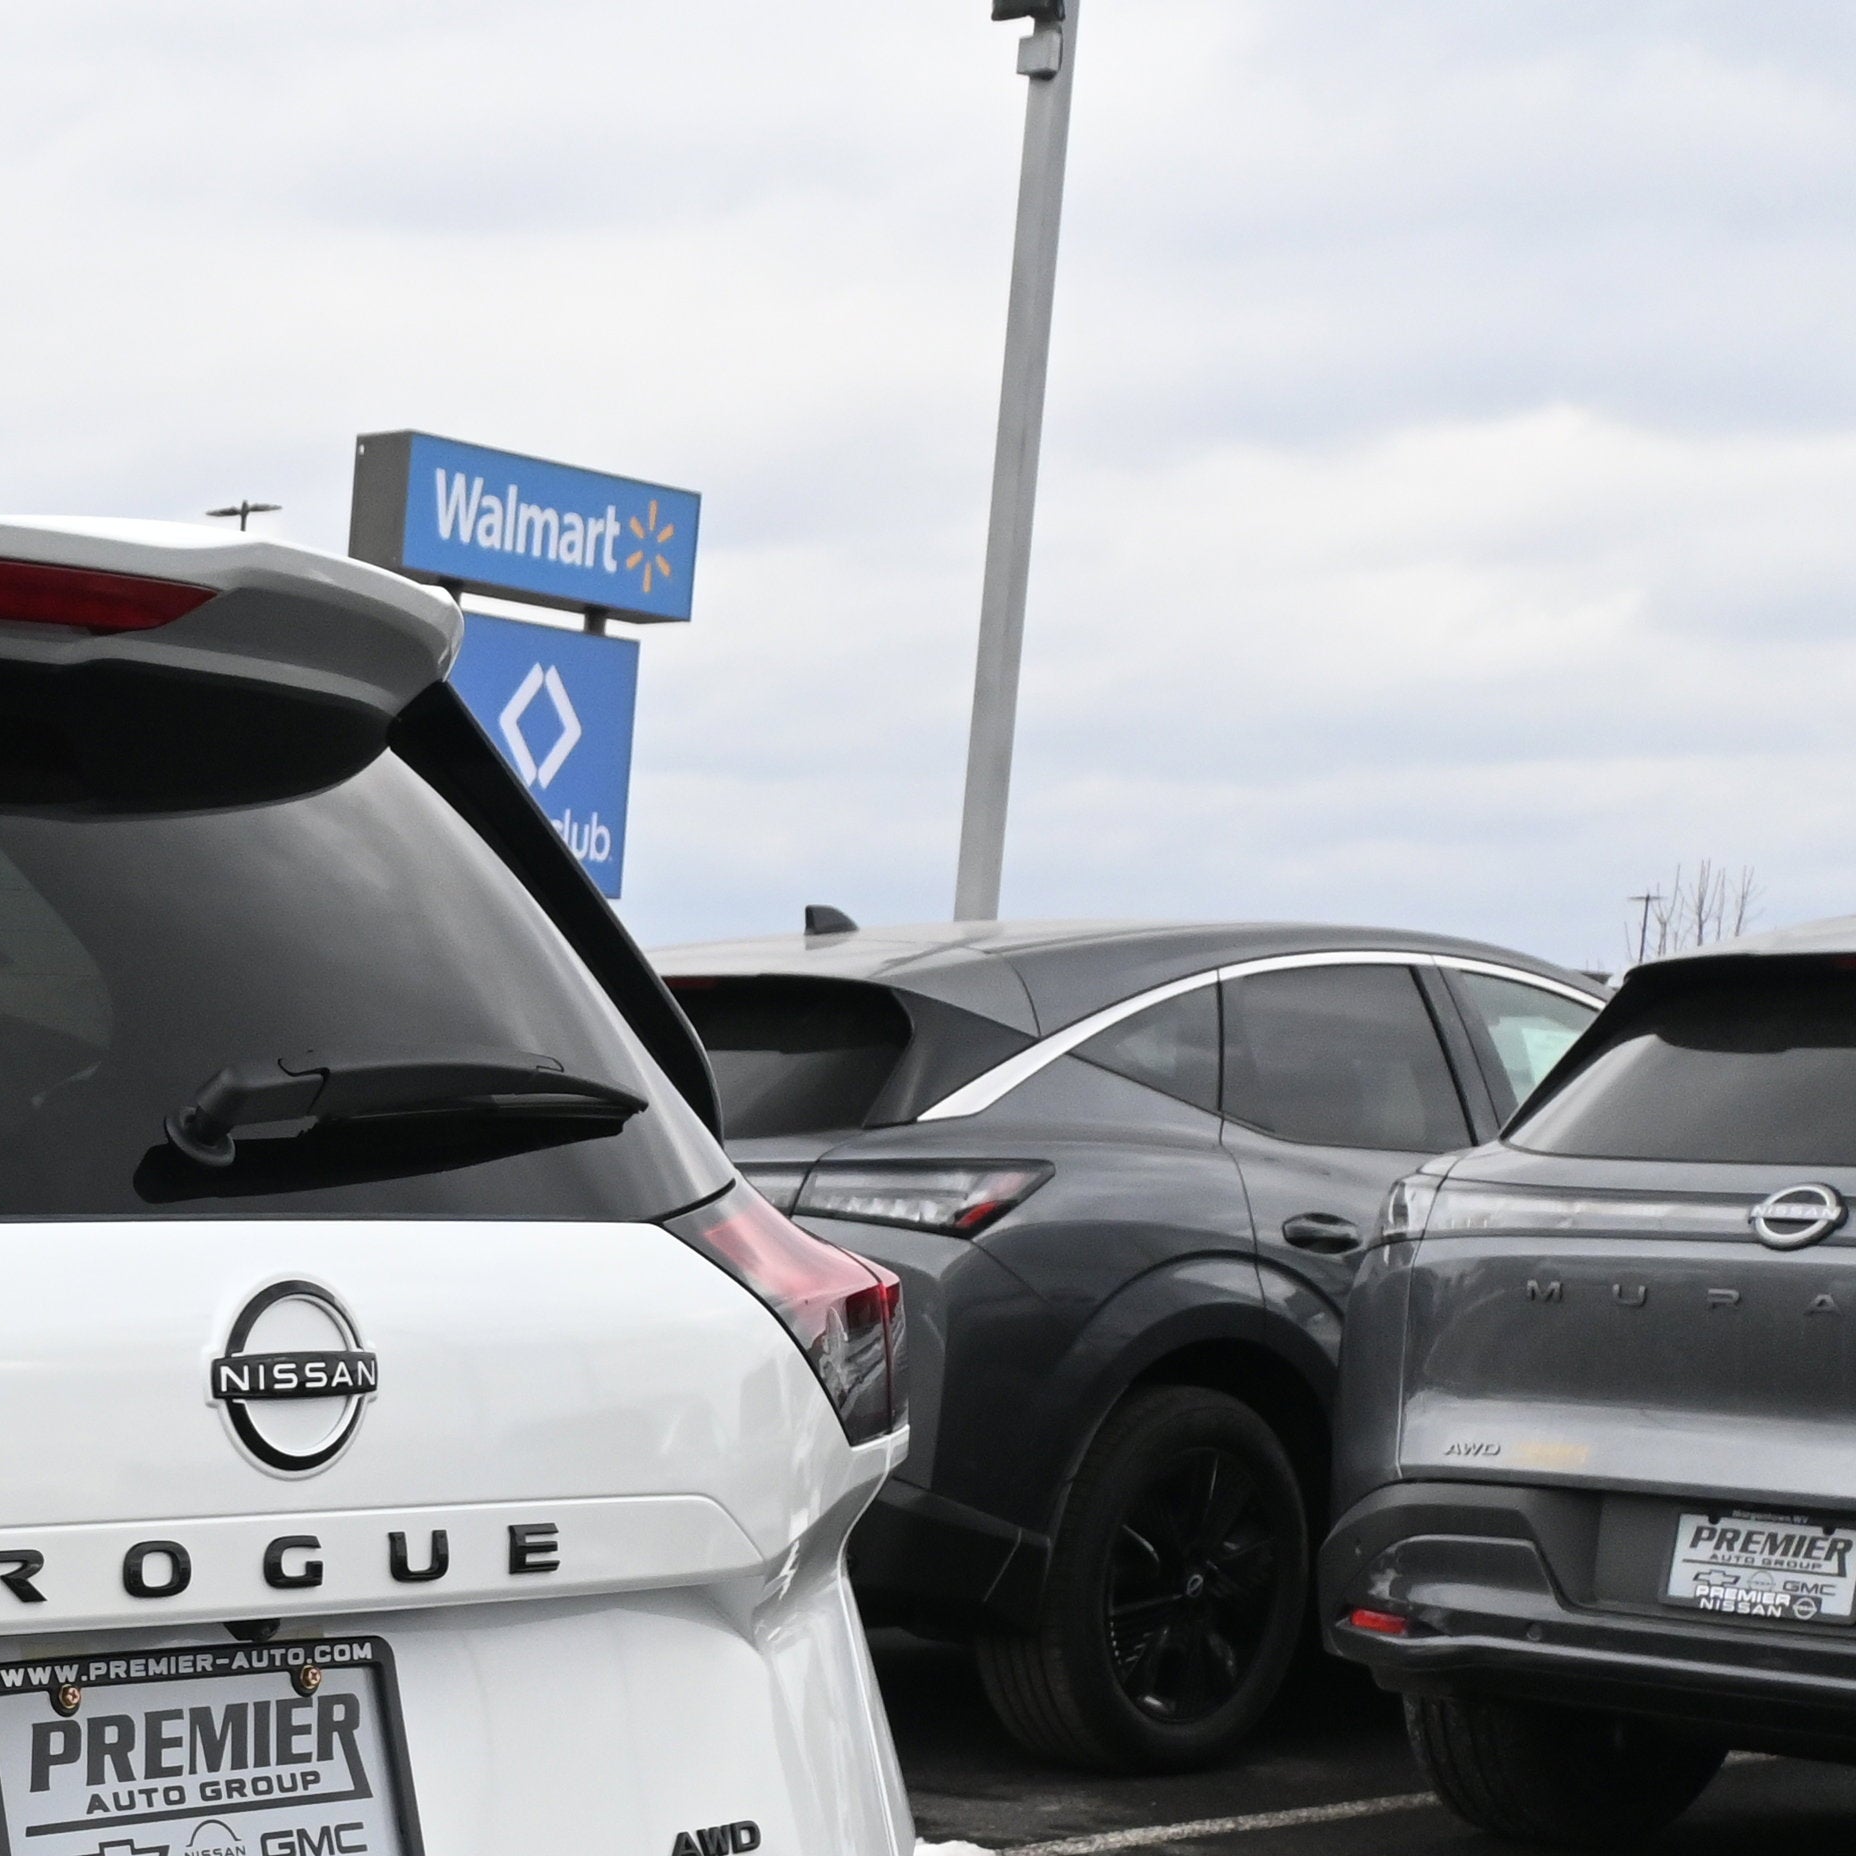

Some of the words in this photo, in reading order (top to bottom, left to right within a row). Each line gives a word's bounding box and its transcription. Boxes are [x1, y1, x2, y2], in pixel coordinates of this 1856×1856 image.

[435, 467, 619, 573] Walmart
[1752, 1204, 1840, 1219] NISSAN
[220, 1360, 378, 1394] NISSAN
[1444, 1442, 1501, 1457] AWD
[1689, 1525, 1854, 1578] PREMIER
[1710, 1553, 1756, 1564] AUTO
[1761, 1558, 1823, 1570] GROUP
[1695, 1584, 1792, 1606] PREMIER
[1782, 1580, 1838, 1596] GMC
[1699, 1598, 1783, 1618] NISSAN
[0, 1642, 373, 1687] WWW.PREMIER-AUTO.COM
[29, 1693, 373, 1799] PREMIER
[86, 1783, 186, 1814] AUTO
[200, 1769, 321, 1801] GROUP
